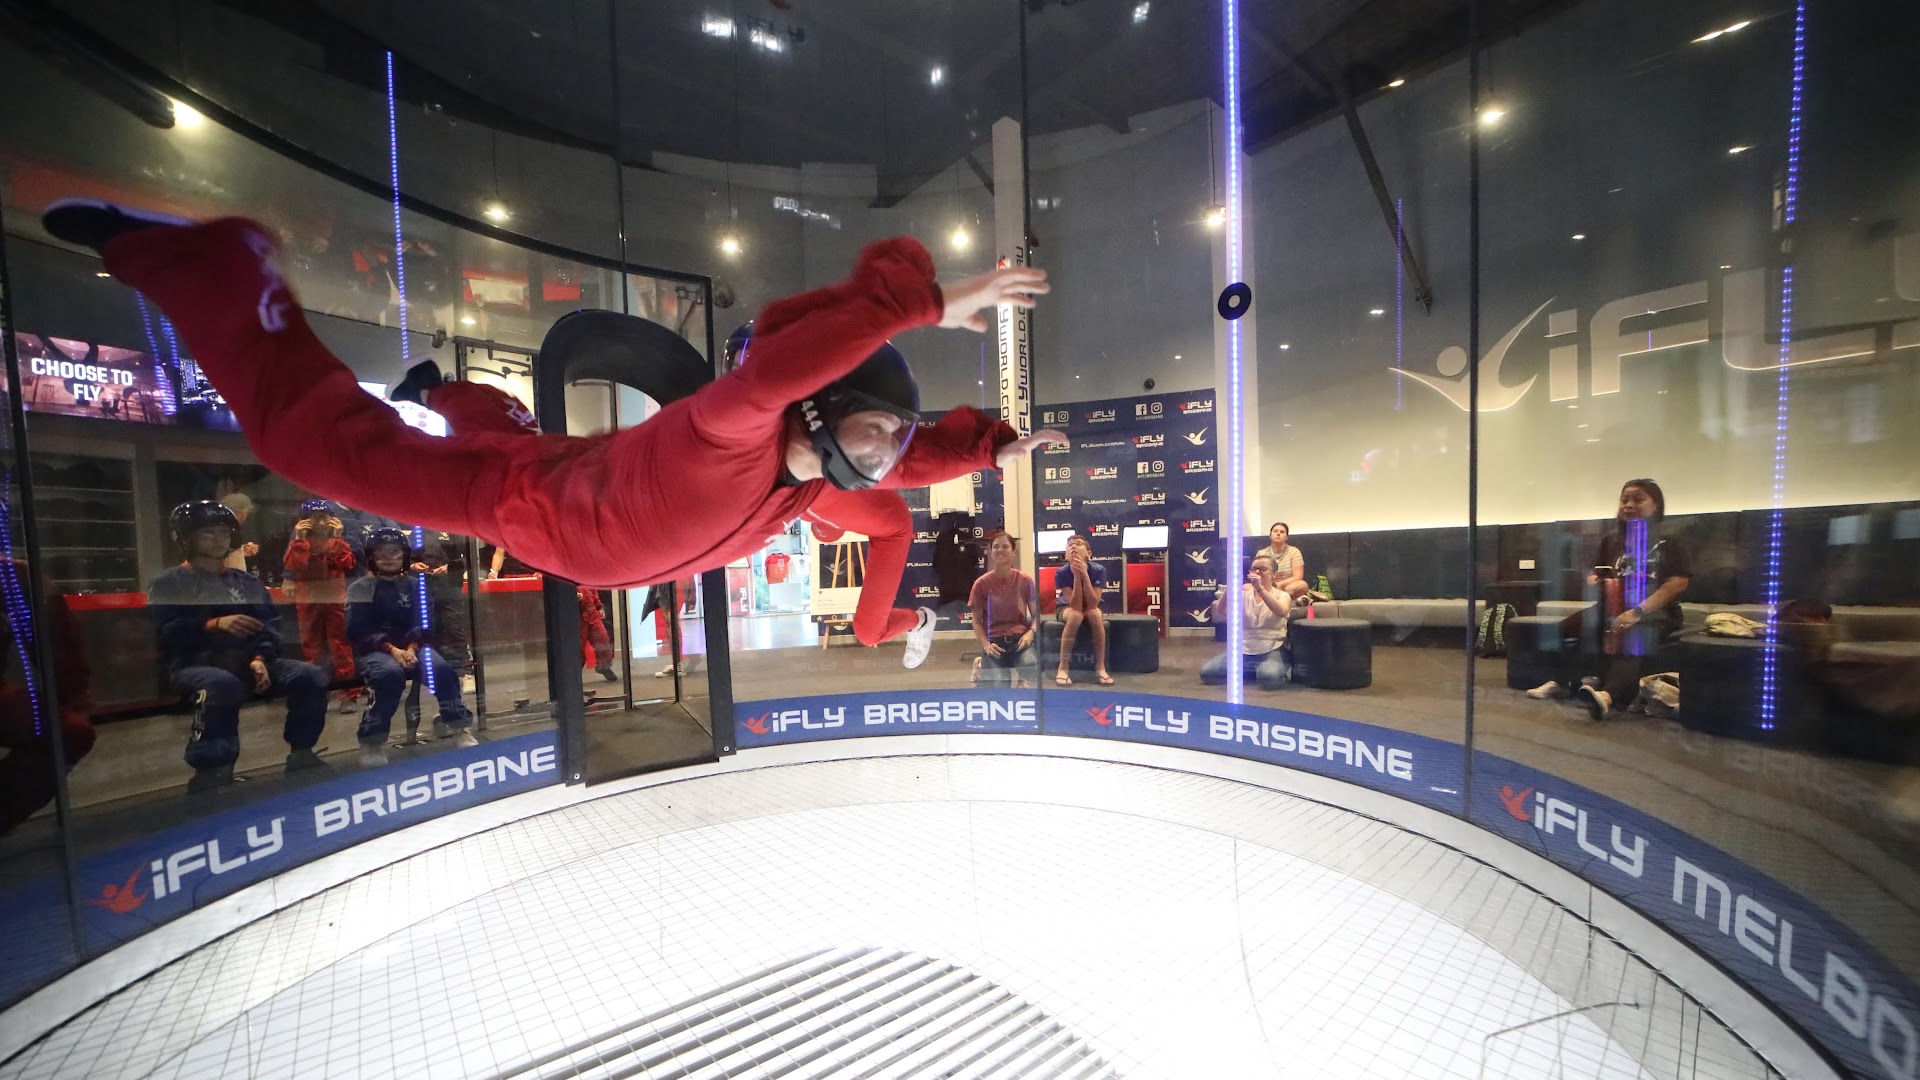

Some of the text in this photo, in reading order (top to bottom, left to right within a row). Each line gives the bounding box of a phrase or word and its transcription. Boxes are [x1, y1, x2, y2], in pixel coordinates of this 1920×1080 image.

[31, 357, 133, 386] CHOOSE TO
[73, 383, 101, 401] FLY
[1187, 400, 1213, 409] iFLY
[1092, 409, 1116, 418] iFLY
[1182, 407, 1213, 415] BRISBANE
[801, 400, 823, 432] 444
[1140, 434, 1164, 443] iFLY
[1188, 459, 1215, 469] iFLY
[1094, 467, 1118, 476] iFLY
[1141, 492, 1166, 501] iFLY
[1049, 498, 1072, 506] iFLY
[1095, 523, 1119, 532] iFLY
[1190, 519, 1216, 528] iFLY
[917, 531, 940, 539] iFLY
[1191, 578, 1217, 587] iFLY
[739, 587, 748, 613] iFLY
[772, 700, 1036, 733] iFLY BRISBANE
[1115, 705, 1413, 781] iFLY BRISBANE
[152, 745, 556, 900] iFLY BRISBANE
[1534, 791, 1645, 878] iFLY
